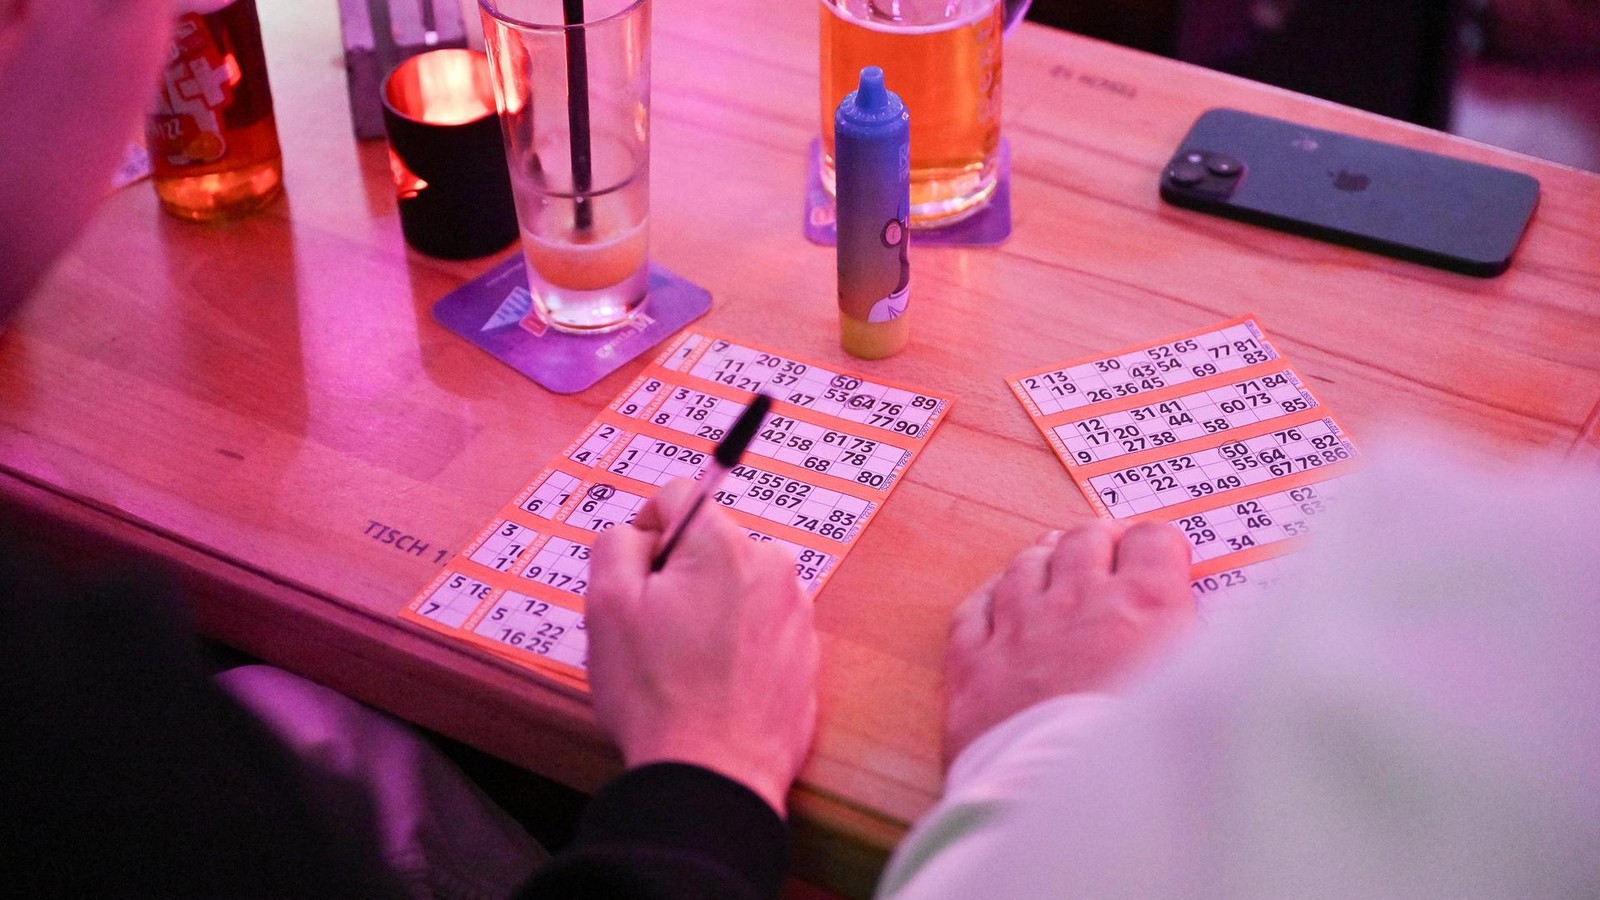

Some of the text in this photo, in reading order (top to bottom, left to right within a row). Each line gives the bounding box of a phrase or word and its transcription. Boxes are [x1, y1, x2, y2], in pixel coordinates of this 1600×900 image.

[683, 349, 692, 357] 1
[1025, 340, 1198, 389] 2 13 30 52 65
[1052, 383, 1076, 395] 19
[1133, 364, 1156, 377] 43
[1157, 358, 1182, 372] 54
[1208, 345, 1229, 358] 77
[1234, 339, 1257, 352] 81
[646, 381, 661, 392] 8
[716, 342, 937, 410] 7 20 30 50 89
[725, 360, 902, 415] 11 37 53 64 76
[1087, 389, 1112, 402] 26
[1113, 383, 1138, 396] 36
[1142, 377, 1164, 389] 45
[1192, 363, 1216, 377] 69
[1243, 350, 1268, 364] 83
[623, 404, 637, 414] 9
[715, 371, 921, 437] 14 21 47 77 90
[1077, 374, 1288, 432] 12 31 41 71 84
[1087, 393, 1271, 445] 17 20 44 60 73
[599, 427, 615, 439] 2
[675, 389, 876, 453] 3 15 41 61 73
[686, 407, 866, 466] 18 42 58 78
[1078, 398, 1307, 463] 9 27 38 58 85
[576, 451, 591, 462] 4
[655, 413, 883, 486] 8 28 68 80
[1114, 430, 1302, 484] 16 21 32 50 76
[656, 443, 811, 497] 10 26 44 55 62
[1104, 490, 1118, 503] 7
[1150, 476, 1178, 491] 22
[1232, 456, 1258, 470] 55
[1258, 449, 1285, 464] 64
[1311, 435, 1339, 449] 82
[1187, 483, 1213, 497] 39
[1217, 476, 1241, 489] 49
[1270, 461, 1291, 476] 67
[1295, 455, 1322, 469] 78
[1322, 447, 1348, 462] 86
[559, 494, 570, 505] 1
[591, 486, 610, 501] 4
[613, 462, 846, 539] 2 45 74 86
[628, 450, 856, 526] 1 59 67 83
[527, 500, 543, 511] 6
[582, 501, 598, 512] 6
[1179, 488, 1317, 531] 28 42 62
[364, 520, 430, 556] TISCH
[502, 524, 518, 536] 3
[1189, 529, 1216, 545] 29
[1247, 514, 1272, 528] 46
[1227, 535, 1254, 550] 34
[570, 546, 592, 560] 13
[800, 550, 825, 566] 81
[450, 576, 466, 588] 5
[526, 567, 542, 578] 9
[548, 573, 572, 587] 17
[1192, 578, 1218, 593] 10
[1220, 570, 1246, 586] 23
[424, 603, 440, 614] 7
[492, 608, 508, 620] 5
[537, 623, 564, 640] 22
[525, 600, 548, 616] 12
[502, 629, 552, 654] 16 25
